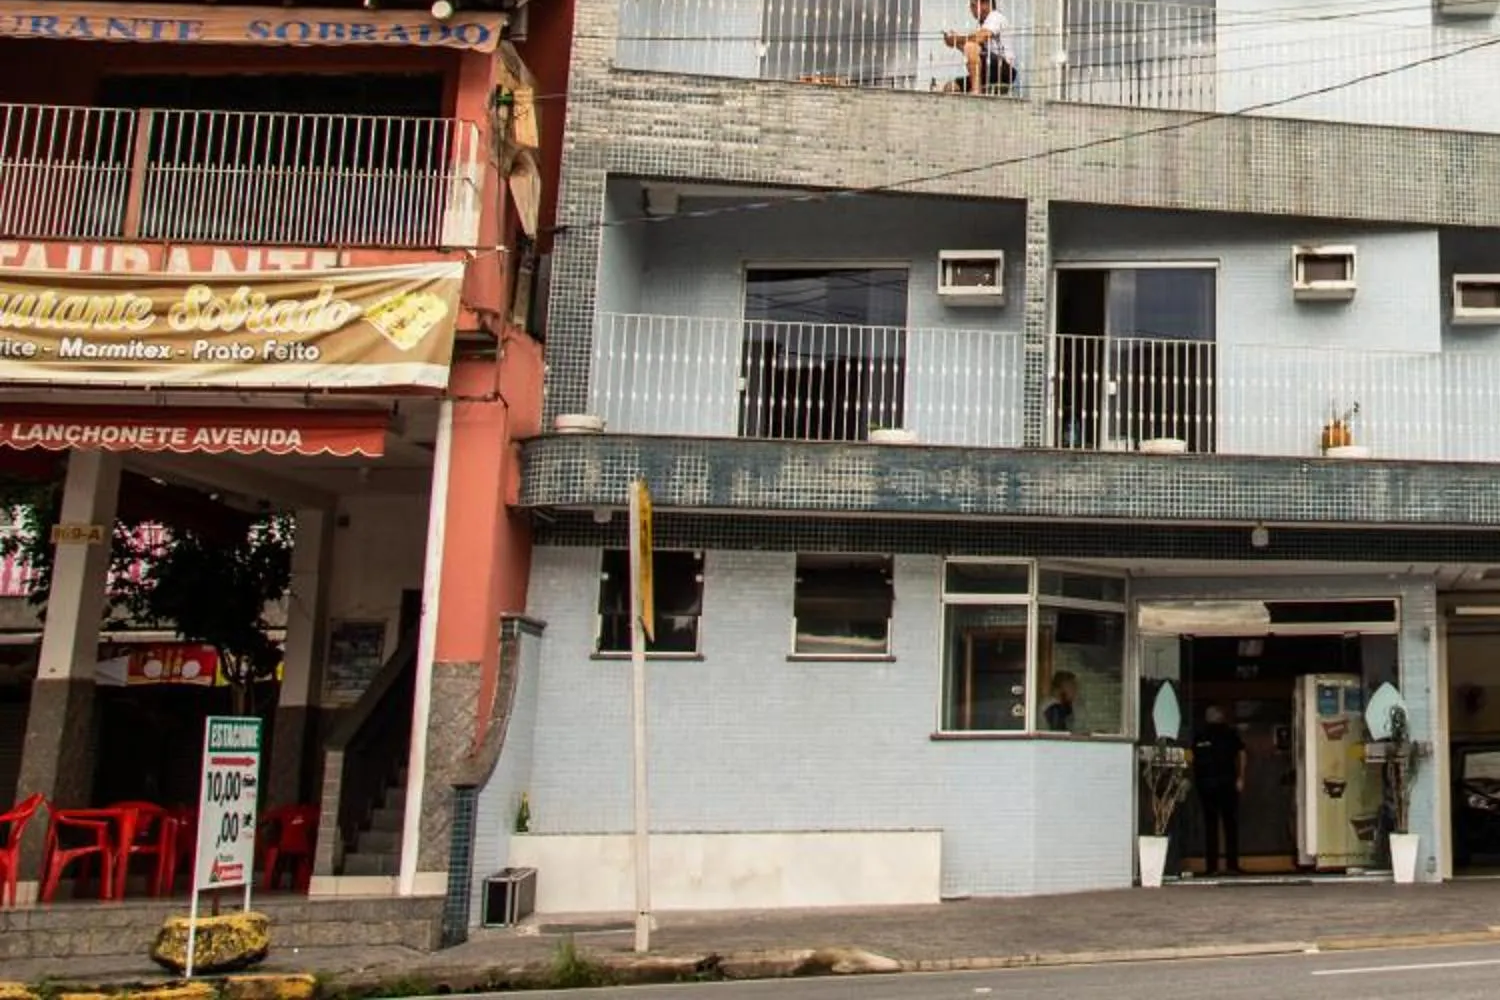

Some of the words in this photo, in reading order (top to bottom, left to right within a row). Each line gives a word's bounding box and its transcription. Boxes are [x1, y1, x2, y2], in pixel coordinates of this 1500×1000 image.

[246, 19, 491, 45] SOBRADO
[167, 284, 363, 333] Sobrado
[59, 336, 172, 360] Marmitex
[192, 340, 256, 361] Prato
[262, 339, 321, 361] Feito
[11, 423, 187, 445] LANCHONETE
[192, 427, 303, 447] AVENIDA
[206, 770, 242, 806] 10,00
